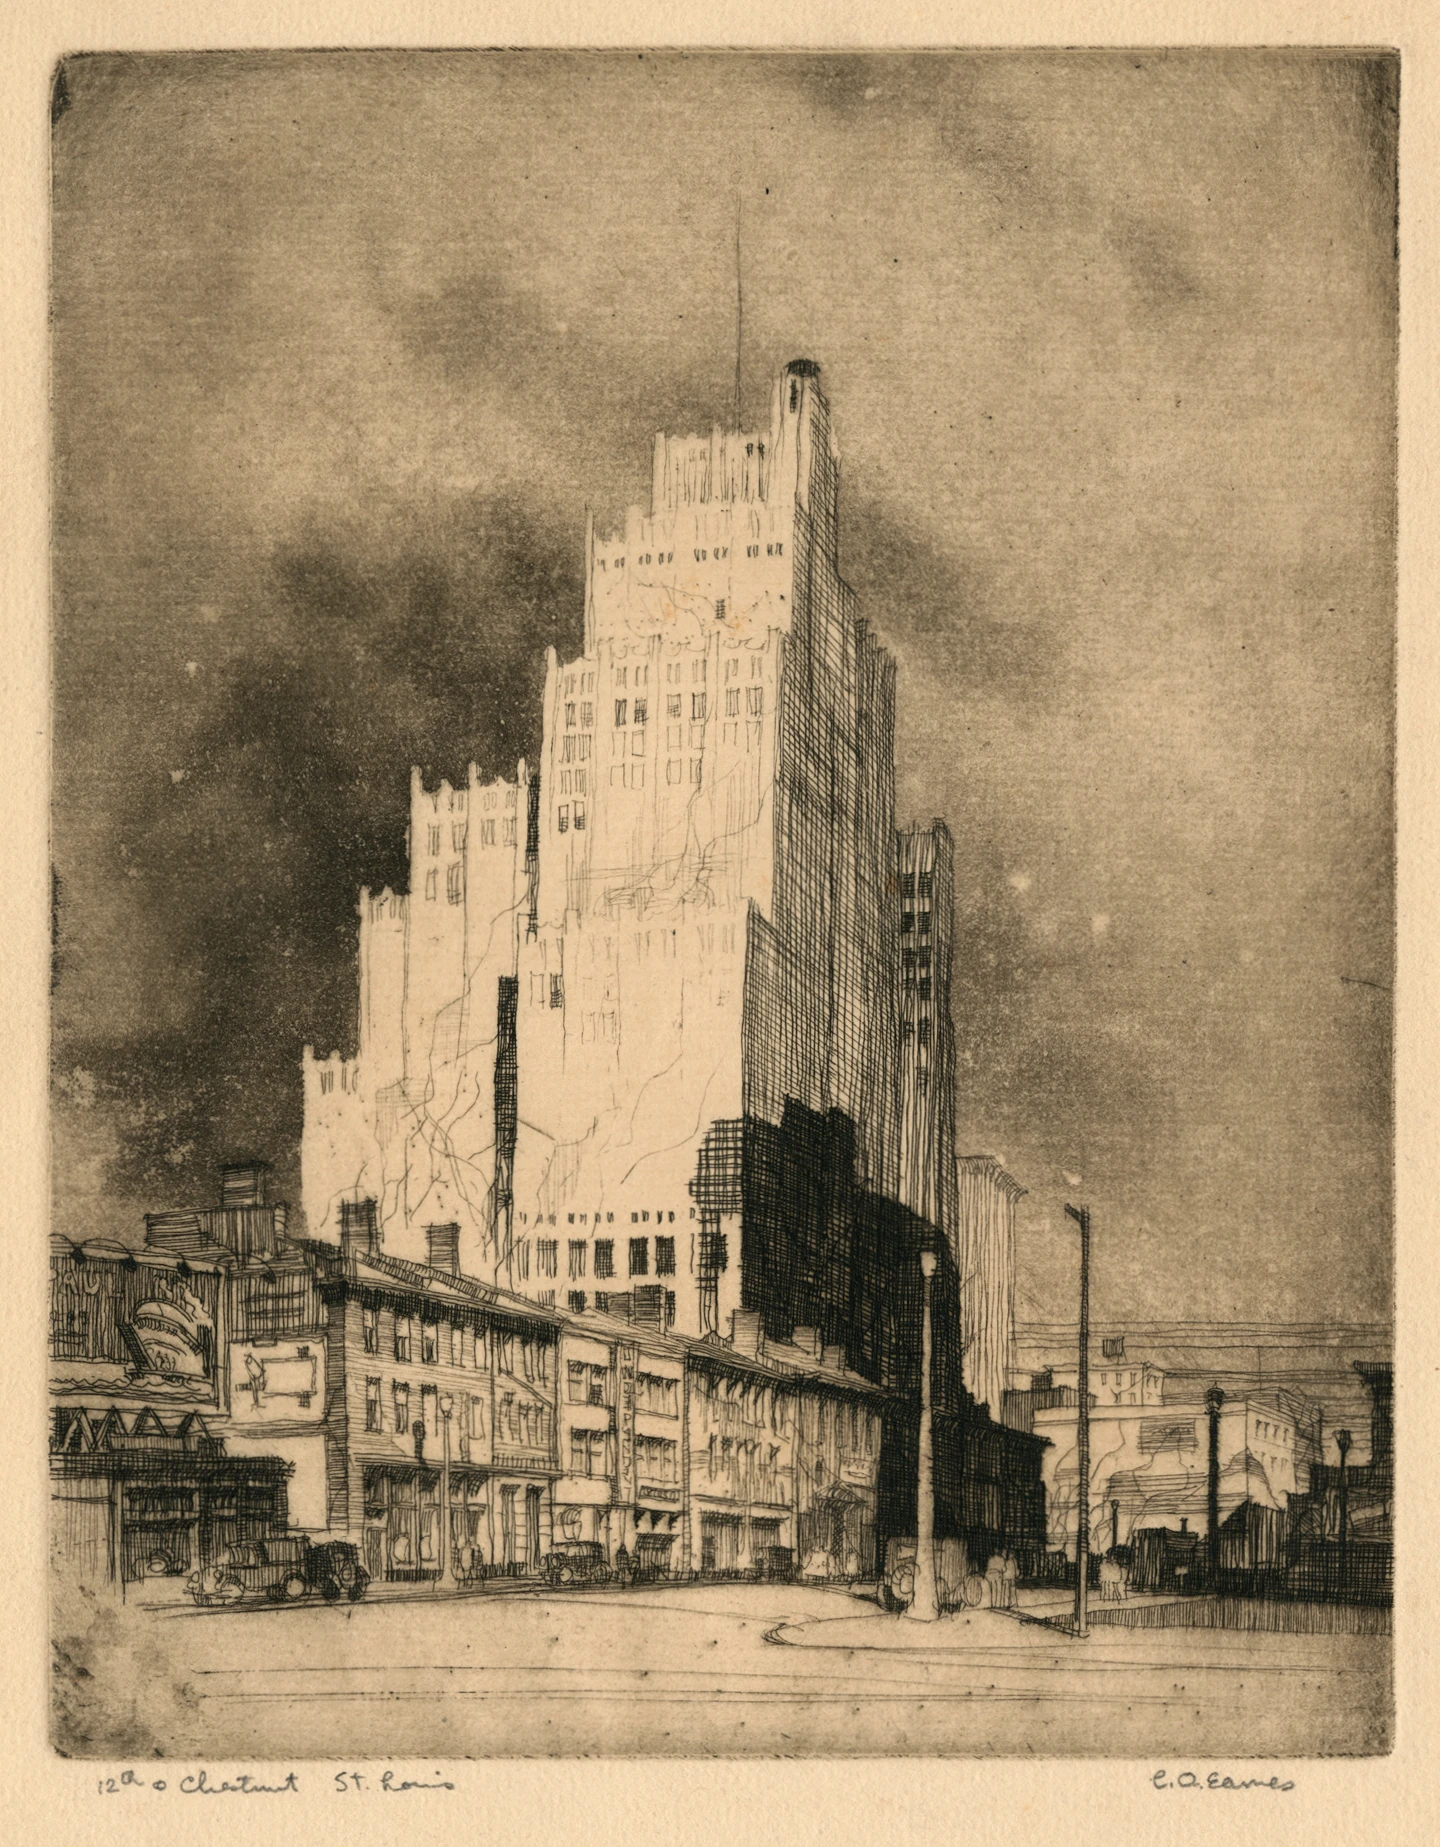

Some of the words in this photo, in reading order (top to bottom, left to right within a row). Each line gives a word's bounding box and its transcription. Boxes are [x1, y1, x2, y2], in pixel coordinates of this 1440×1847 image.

[97, 1770, 145, 1795] 12th
[179, 1770, 299, 1794] Chestnut
[379, 1771, 455, 1792] Louis
